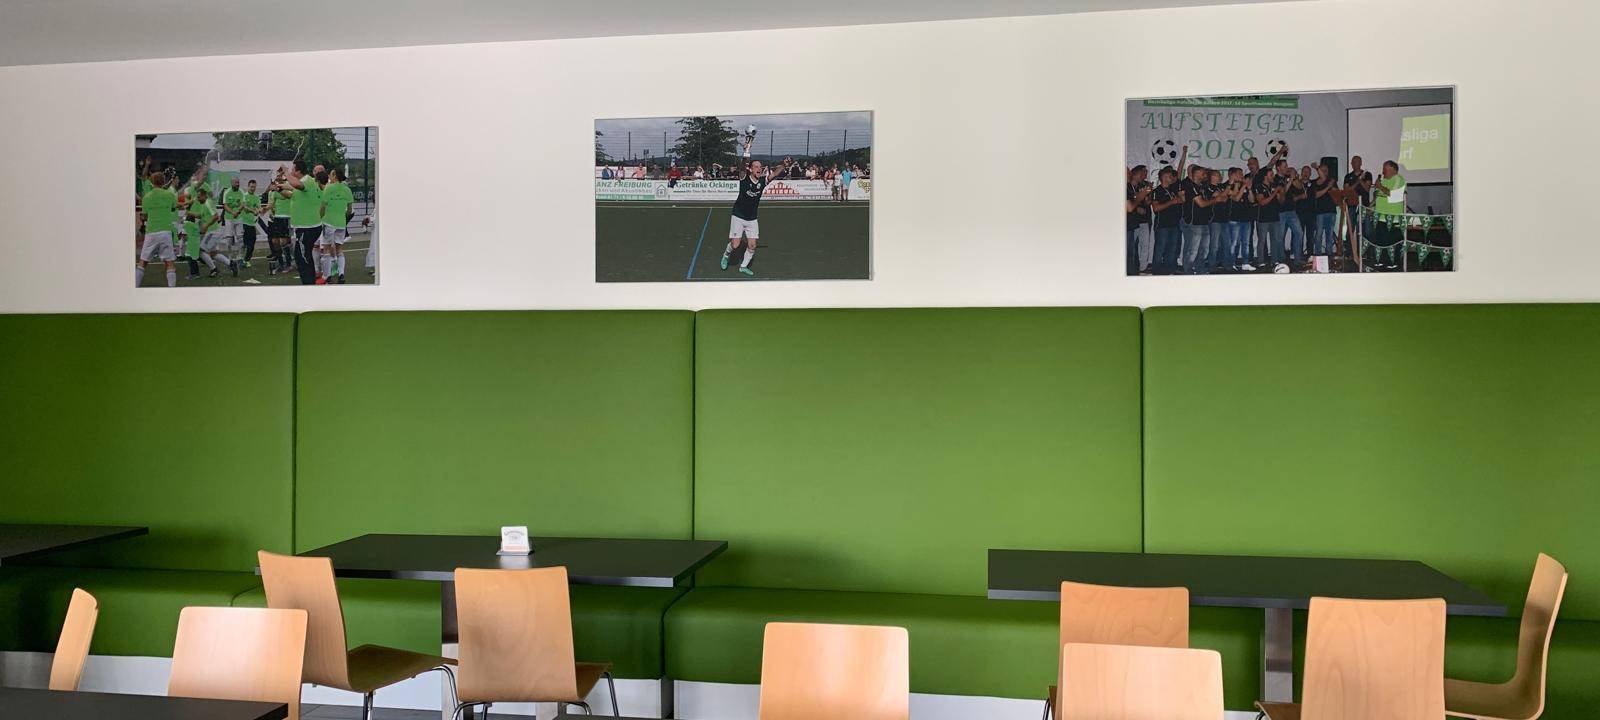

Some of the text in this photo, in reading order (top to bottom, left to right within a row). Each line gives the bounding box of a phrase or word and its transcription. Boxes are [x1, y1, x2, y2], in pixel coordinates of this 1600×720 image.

[1140, 111, 1305, 135] AUFSTEIGER
[1401, 128, 1439, 144] sliga
[1188, 138, 1255, 161] 2018
[709, 181, 738, 189] Ockinga
